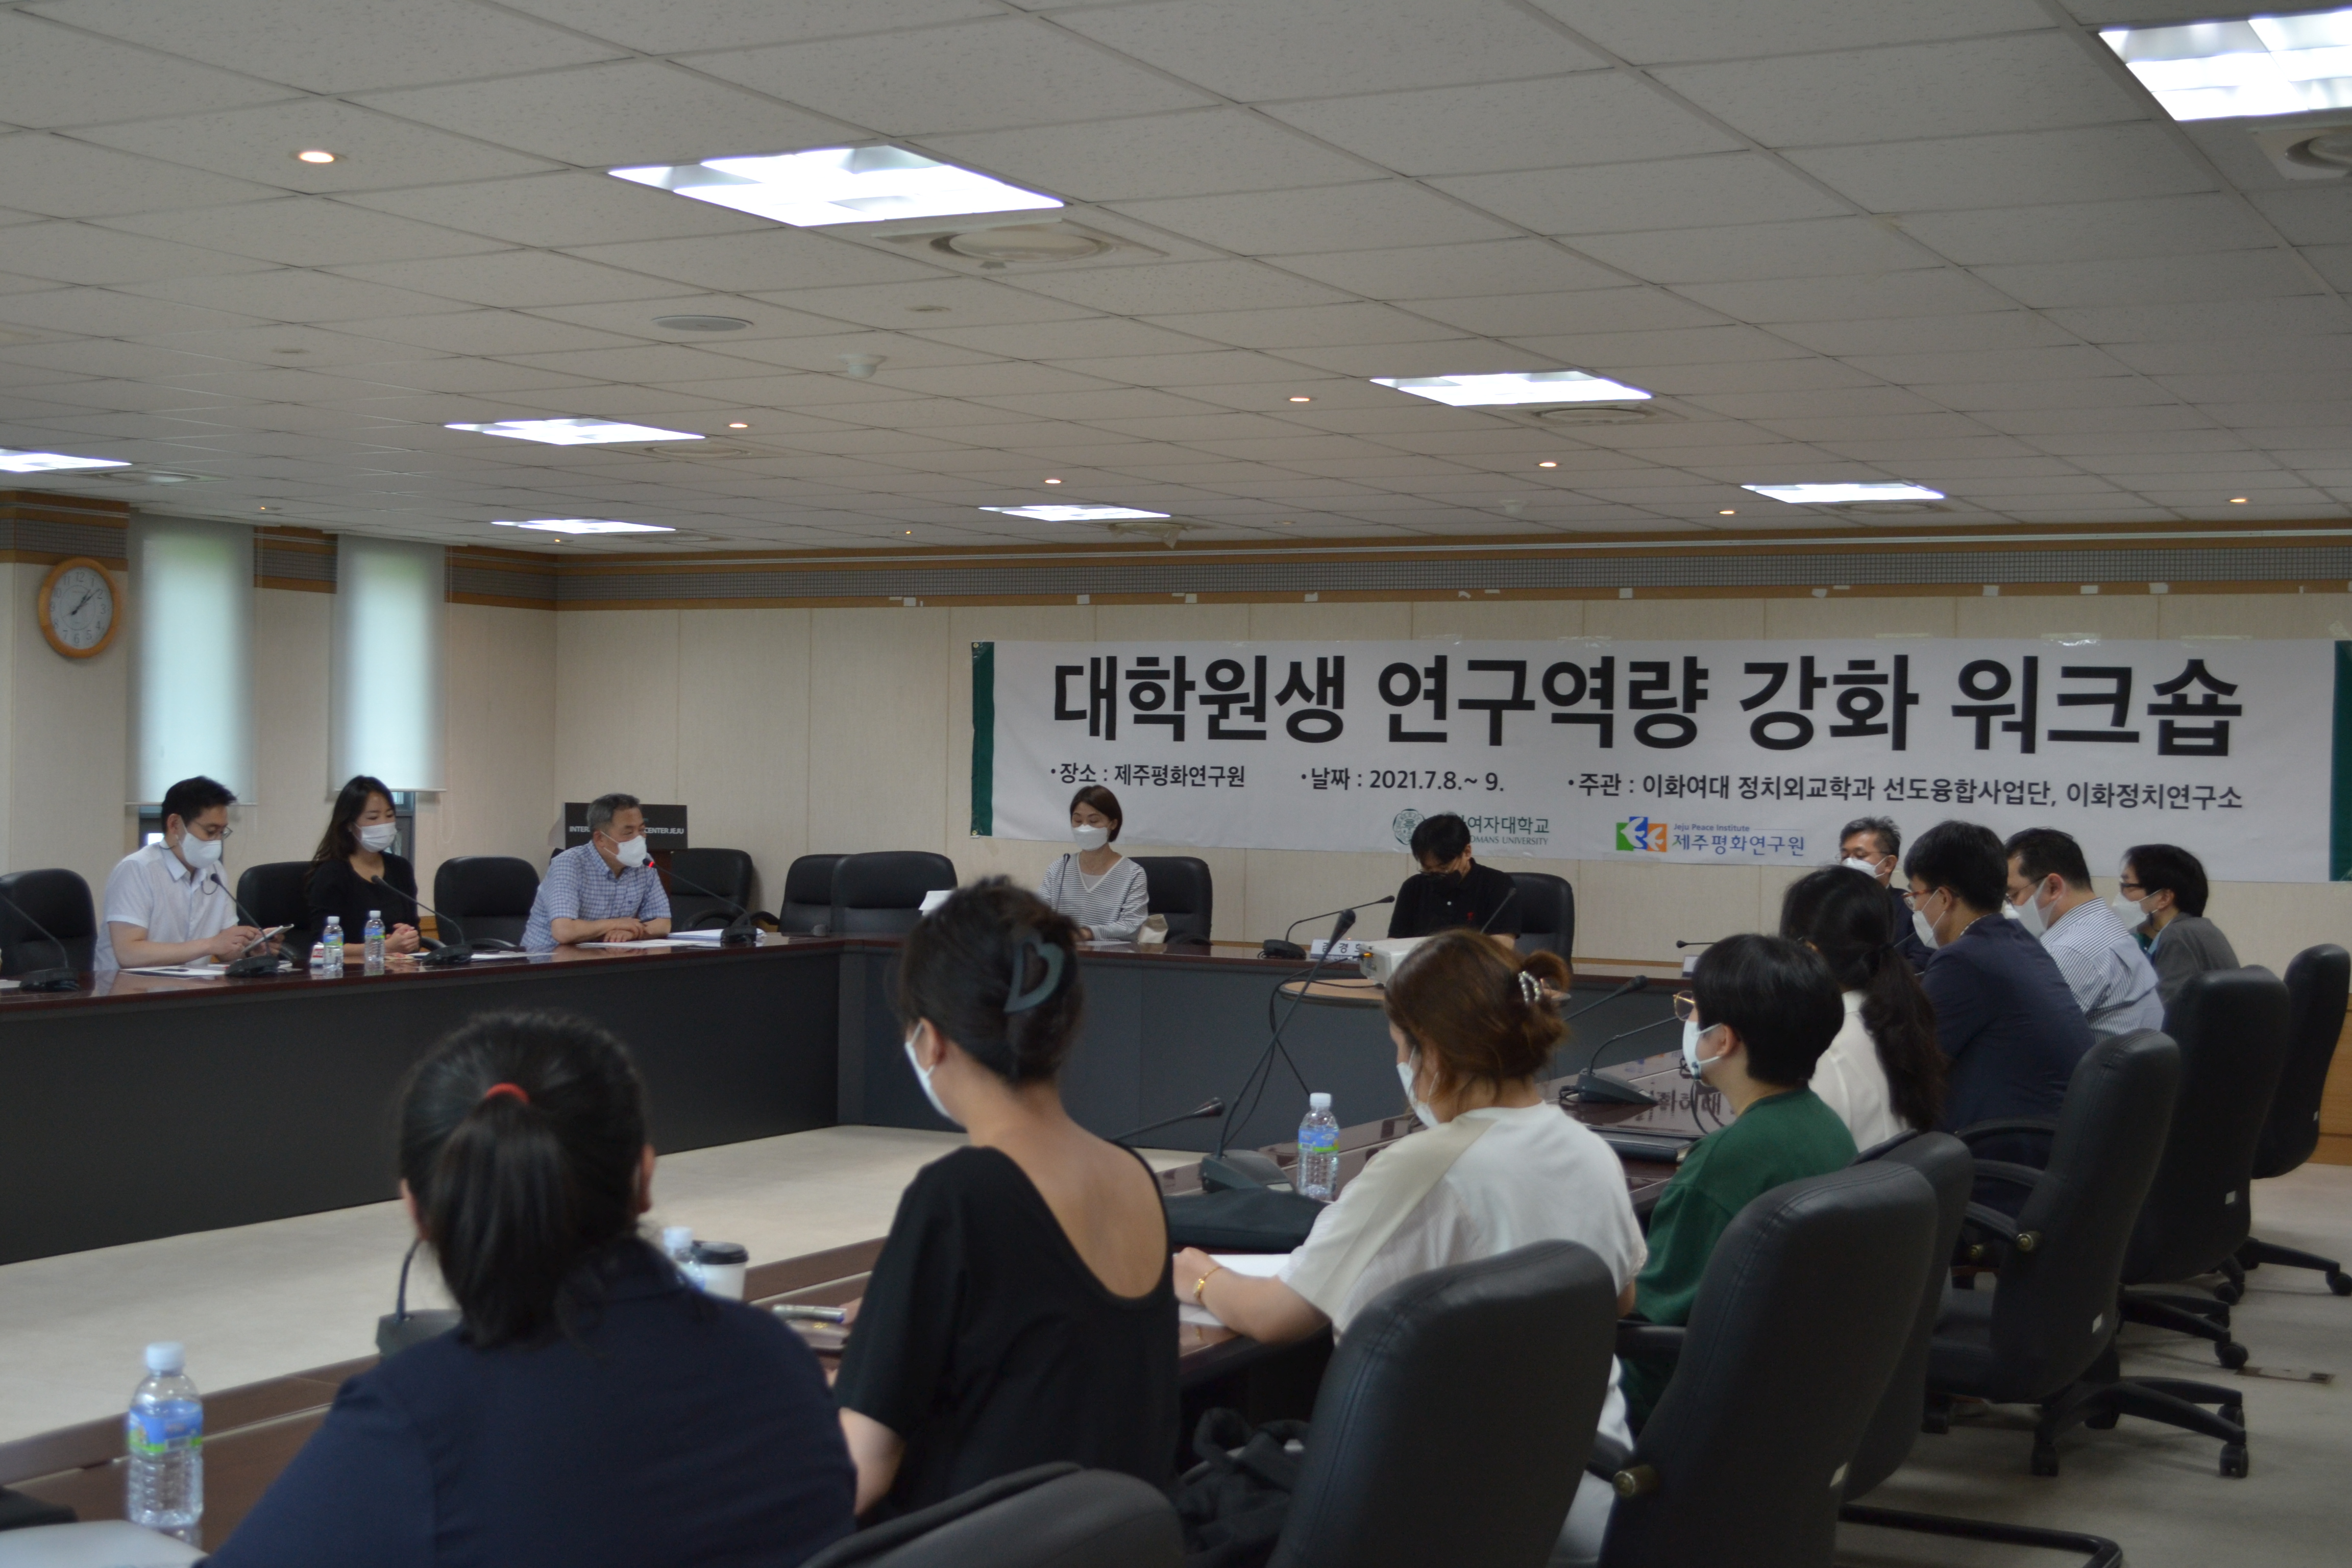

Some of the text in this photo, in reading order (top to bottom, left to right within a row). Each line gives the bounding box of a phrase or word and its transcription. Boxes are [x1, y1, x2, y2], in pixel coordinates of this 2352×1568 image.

[76, 572, 86, 582] 12
[1054, 654, 2243, 757] 대학원생 연구역량 강화 워크숍
[1060, 763, 1096, 784] 장소
[1114, 764, 1244, 788] 제주평화연구원
[1311, 767, 1351, 791] 날짜
[1578, 773, 1622, 797] 주관
[1643, 774, 1729, 799] 이화여대
[1737, 775, 1875, 801] 정치외교학과
[1883, 777, 2056, 808] 선도융합사업단,
[2066, 781, 2243, 811] 이화정치연구소
[1673, 823, 1750, 832] Jeju Peace Institute
[1502, 836, 1549, 845] UNIVERSITY
[1673, 834, 1804, 856] 제주평화연구원
